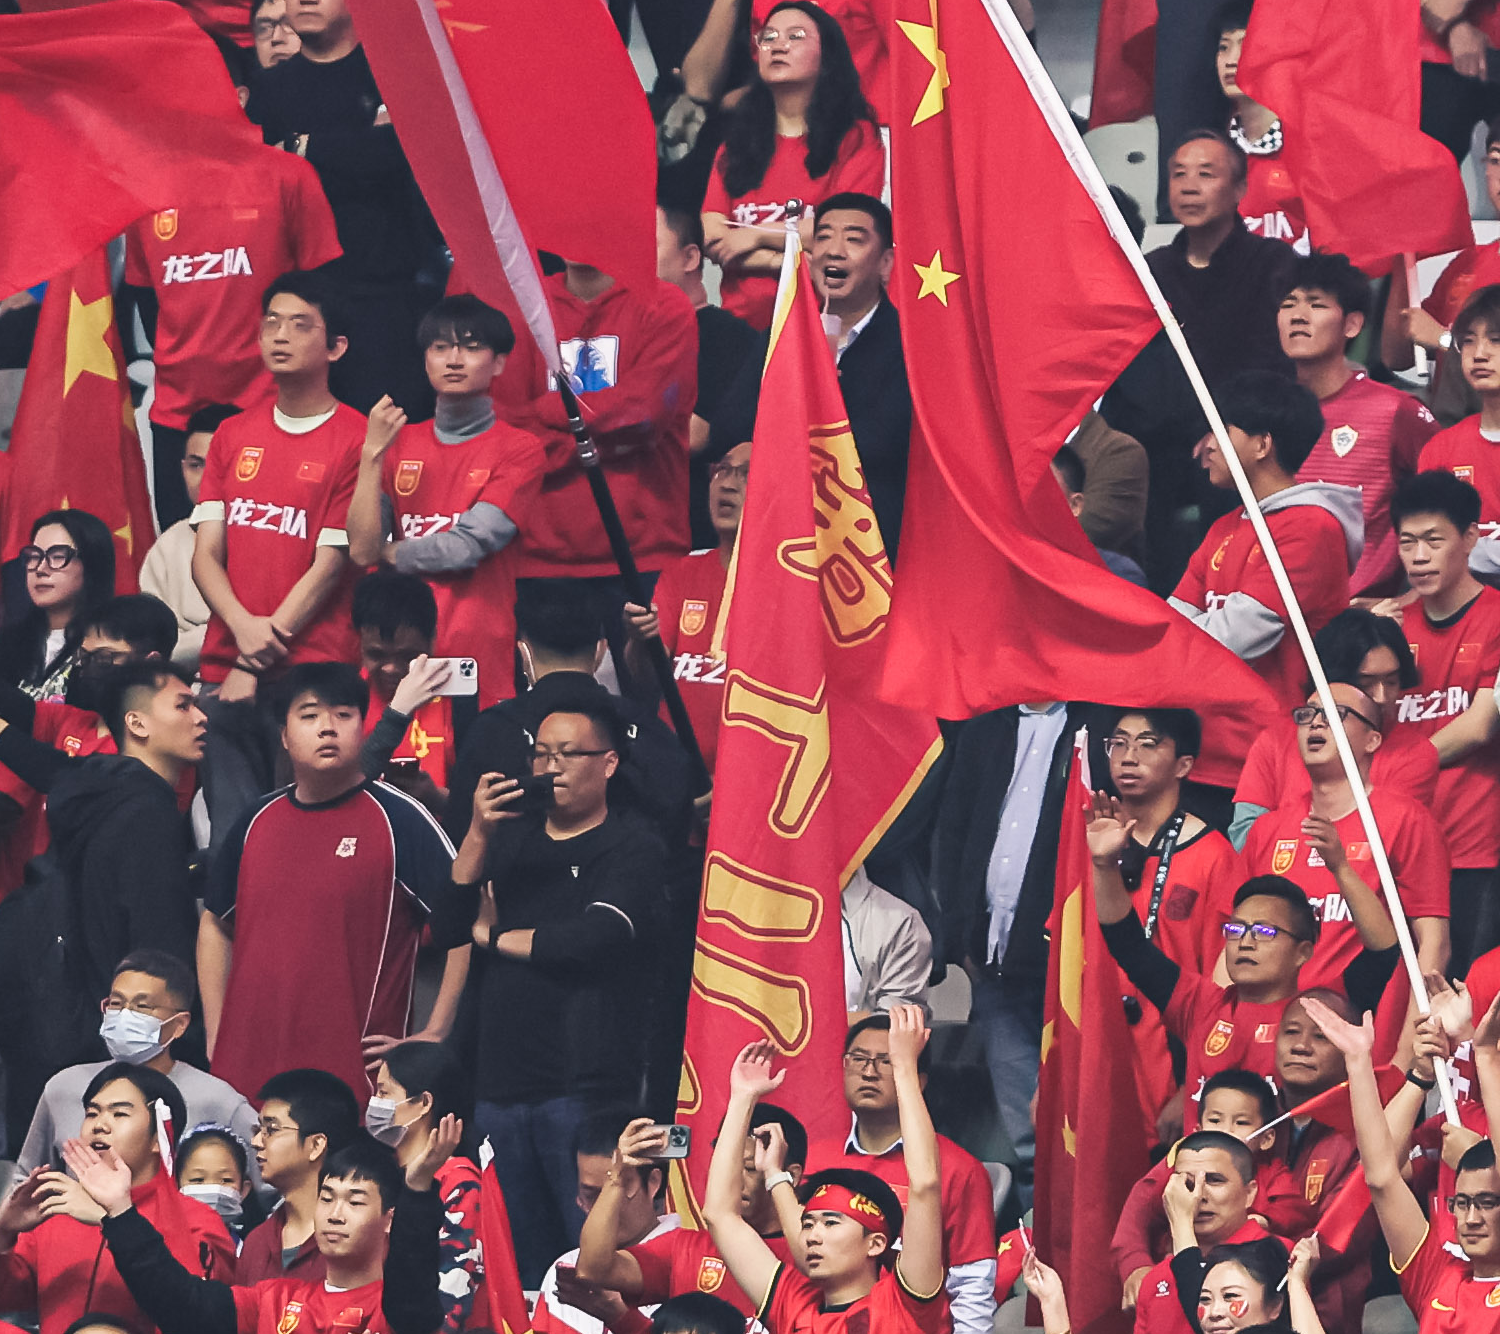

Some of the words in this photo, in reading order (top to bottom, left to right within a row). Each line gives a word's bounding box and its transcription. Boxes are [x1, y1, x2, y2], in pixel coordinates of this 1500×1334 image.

[163, 247, 252, 283] 龙之队
[223, 498, 306, 538] 龙之队
[1395, 684, 1469, 724] 龙之队
